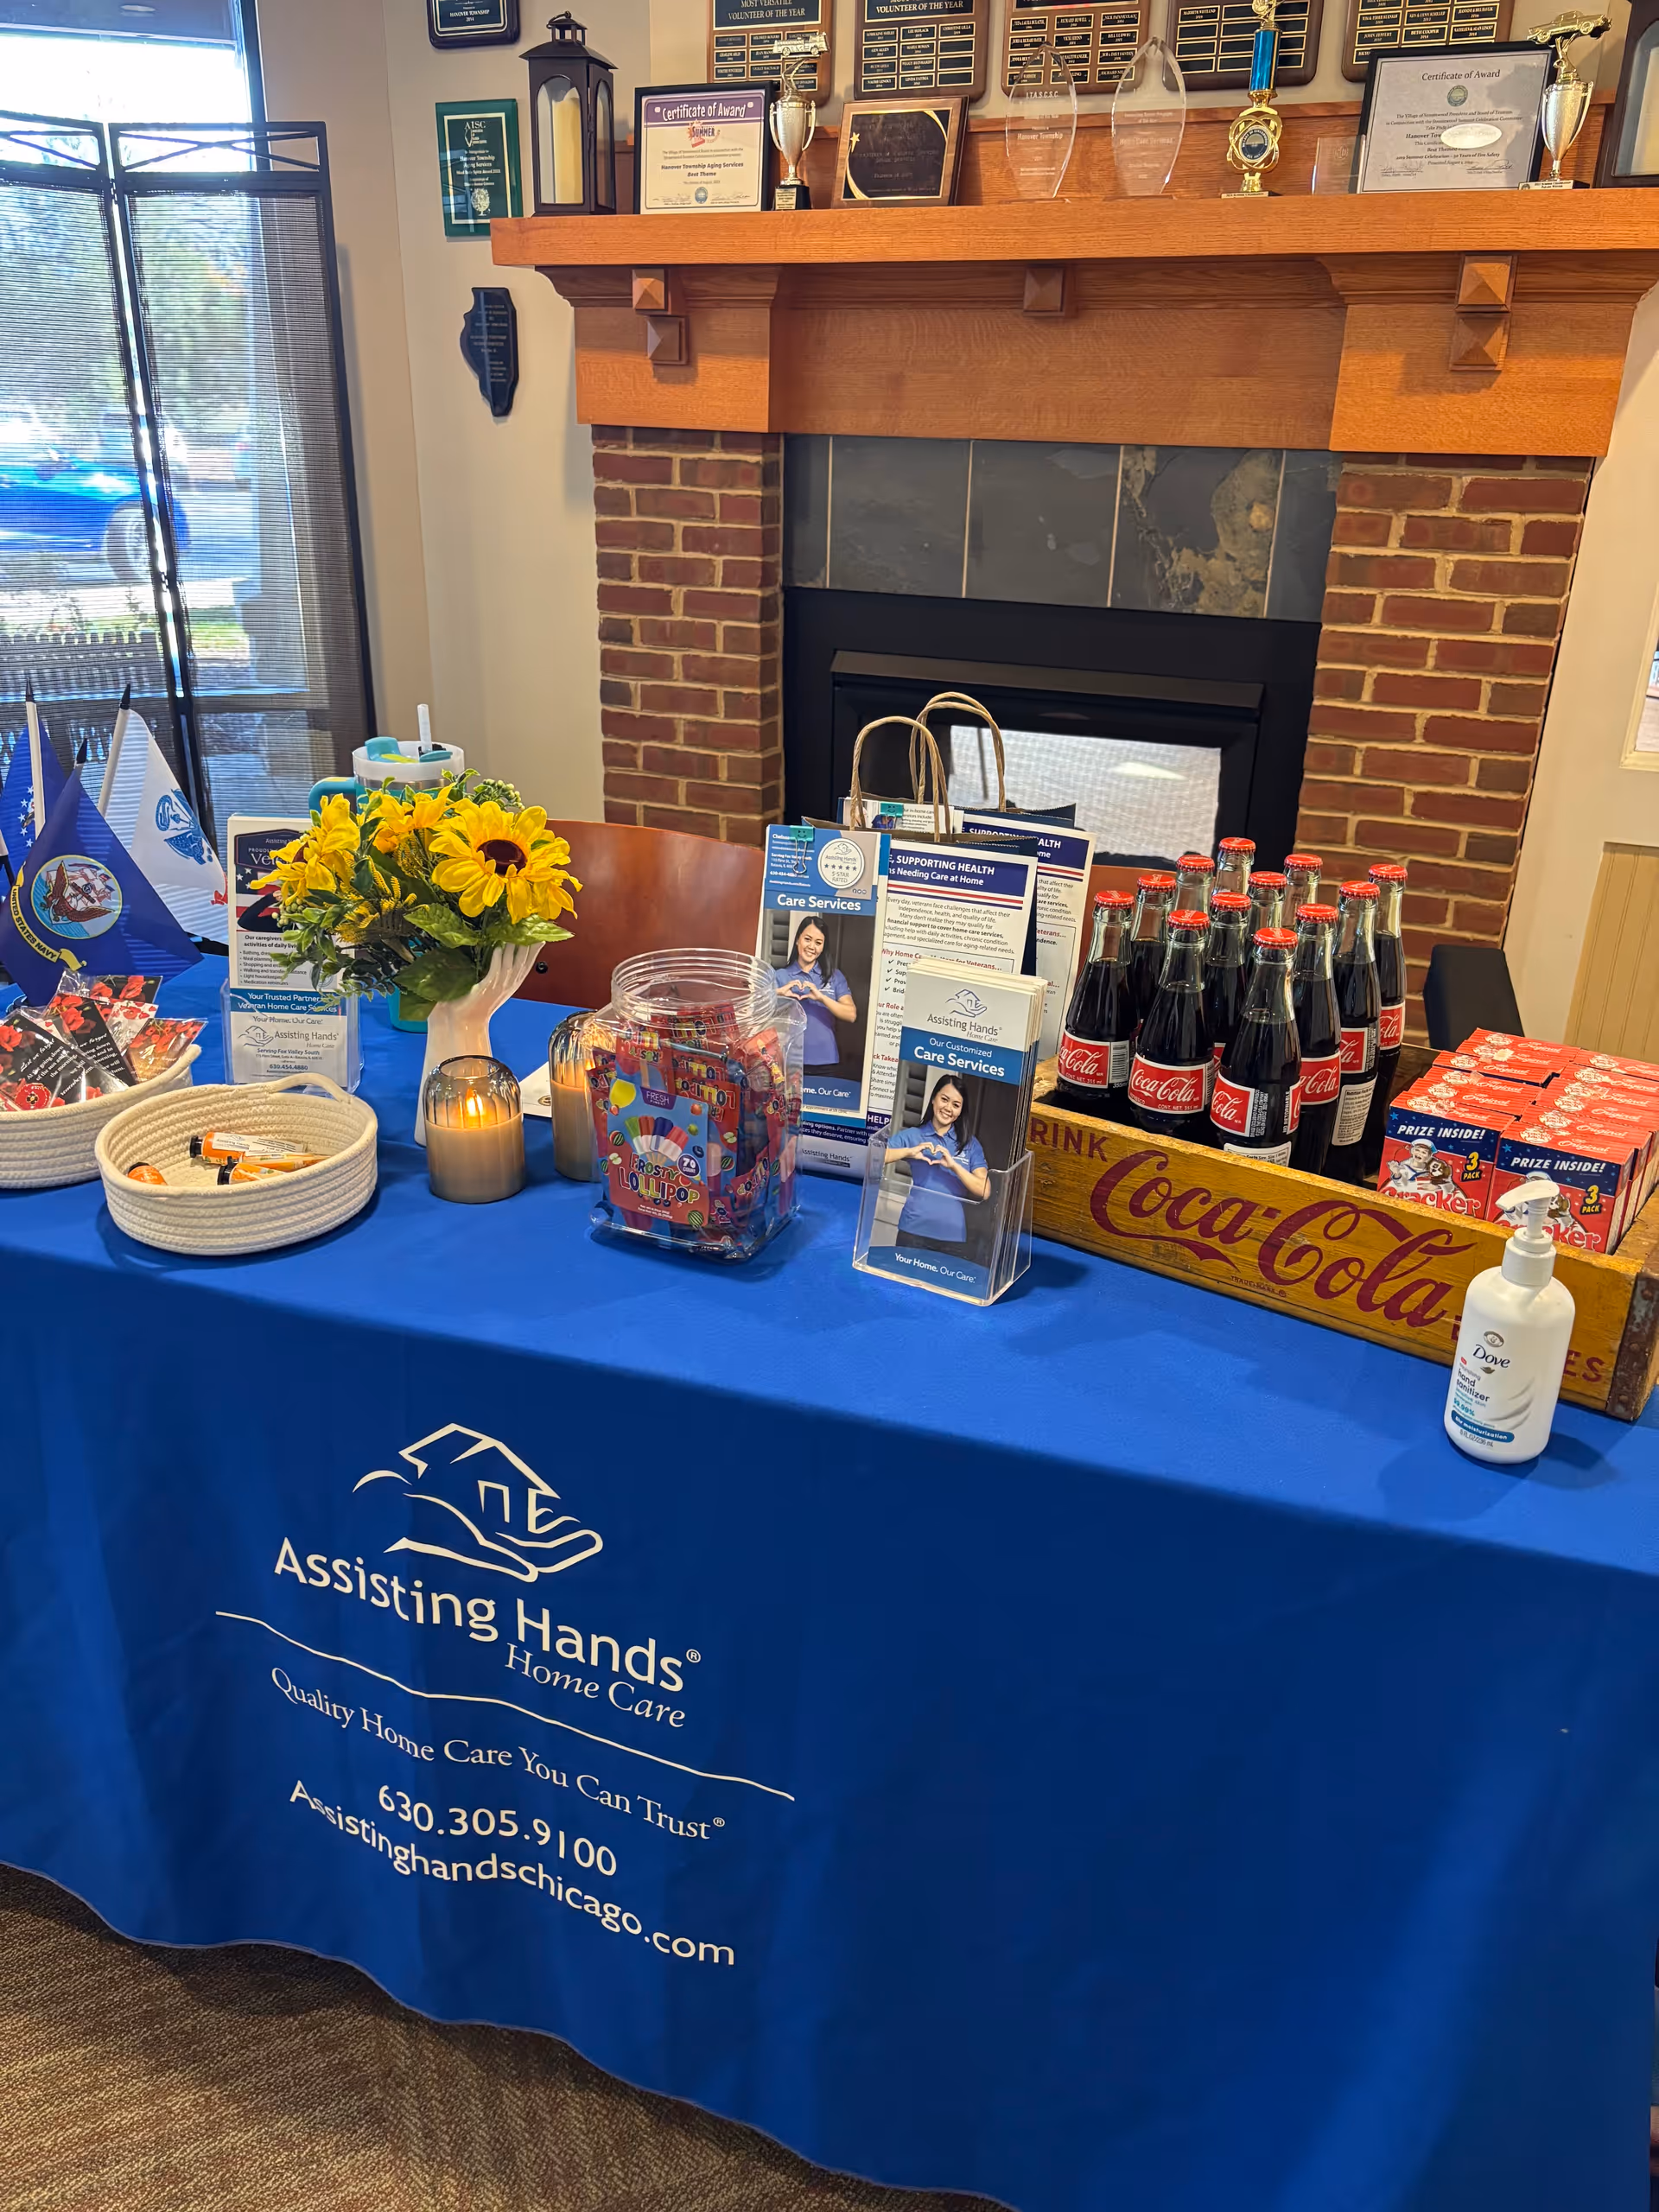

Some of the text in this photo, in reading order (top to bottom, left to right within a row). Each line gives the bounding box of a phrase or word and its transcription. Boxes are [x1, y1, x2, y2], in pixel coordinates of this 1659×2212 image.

[728, 10, 764, 20] VOLUNTEER
[789, 8, 805, 16] YEAR
[876, 5, 917, 14] VOLUNTEER
[1421, 69, 1501, 81] Certificate of Award
[662, 102, 747, 122] Certificate of Award
[464, 121, 486, 130] AISC
[691, 125, 715, 137] SUMMER
[896, 855, 995, 875] SUPPORTING HEALTH
[897, 868, 930, 880] Needing
[931, 871, 949, 881] Care
[959, 874, 984, 886] Home
[777, 893, 861, 911] Care Services
[912, 899, 932, 908] veterans
[944, 904, 970, 913] challenges
[899, 912, 912, 921] Many
[968, 921, 985, 930] qualify
[909, 920, 930, 929] support
[963, 913, 981, 922] quality
[16, 916, 36, 944] STATES
[35, 942, 57, 959] NAVY
[926, 1014, 968, 1032] Assisting
[274, 1031, 309, 1041] Assisting
[966, 1031, 983, 1040] Home
[21, 1038, 54, 1072] Lest forget
[929, 1038, 992, 1058] Our Customized
[913, 1046, 1005, 1077] Care Services
[1131, 1069, 1199, 1103] Coca-Cola
[645, 1090, 670, 1104] FRESH
[1462, 1095, 1511, 1107] Original
[1591, 1109, 1643, 1122] Original
[1397, 1124, 1485, 1141] PRIZE INSIDE!
[1577, 1125, 1629, 1139] Original
[1558, 1141, 1611, 1154] Original
[629, 1152, 680, 1181] FROSTY
[830, 1154, 850, 1162] Hands
[1466, 1152, 1478, 1171] 3
[1510, 1156, 1606, 1173] PRIZE INSIDE!
[1463, 1171, 1480, 1180] PACK
[619, 1166, 700, 1204] LOLLIPOP
[1586, 1185, 1599, 1204] 3
[1582, 1205, 1600, 1214] PACK
[1090, 1148, 1477, 1327] Coca-Cola
[894, 1253, 912, 1265] Your
[913, 1259, 938, 1273] Home.
[939, 1266, 955, 1277] Our
[1472, 1344, 1511, 1369] Dove
[1458, 1369, 1476, 1388] hand
[1456, 1379, 1491, 1402] sanitizer
[1463, 1421, 1508, 1441] moisturization
[274, 1536, 499, 1643] Assisting
[505, 1643, 687, 1729] Home Care
[270, 1668, 355, 1729] Quality
[360, 1707, 435, 1763] Home
[443, 1739, 513, 1767] Care
[519, 1746, 569, 1789] You
[576, 1775, 631, 1814] Can
[378, 1784, 618, 1877] 630.305.9100
[289, 1780, 735, 1967] Assistinghandschicago.com
